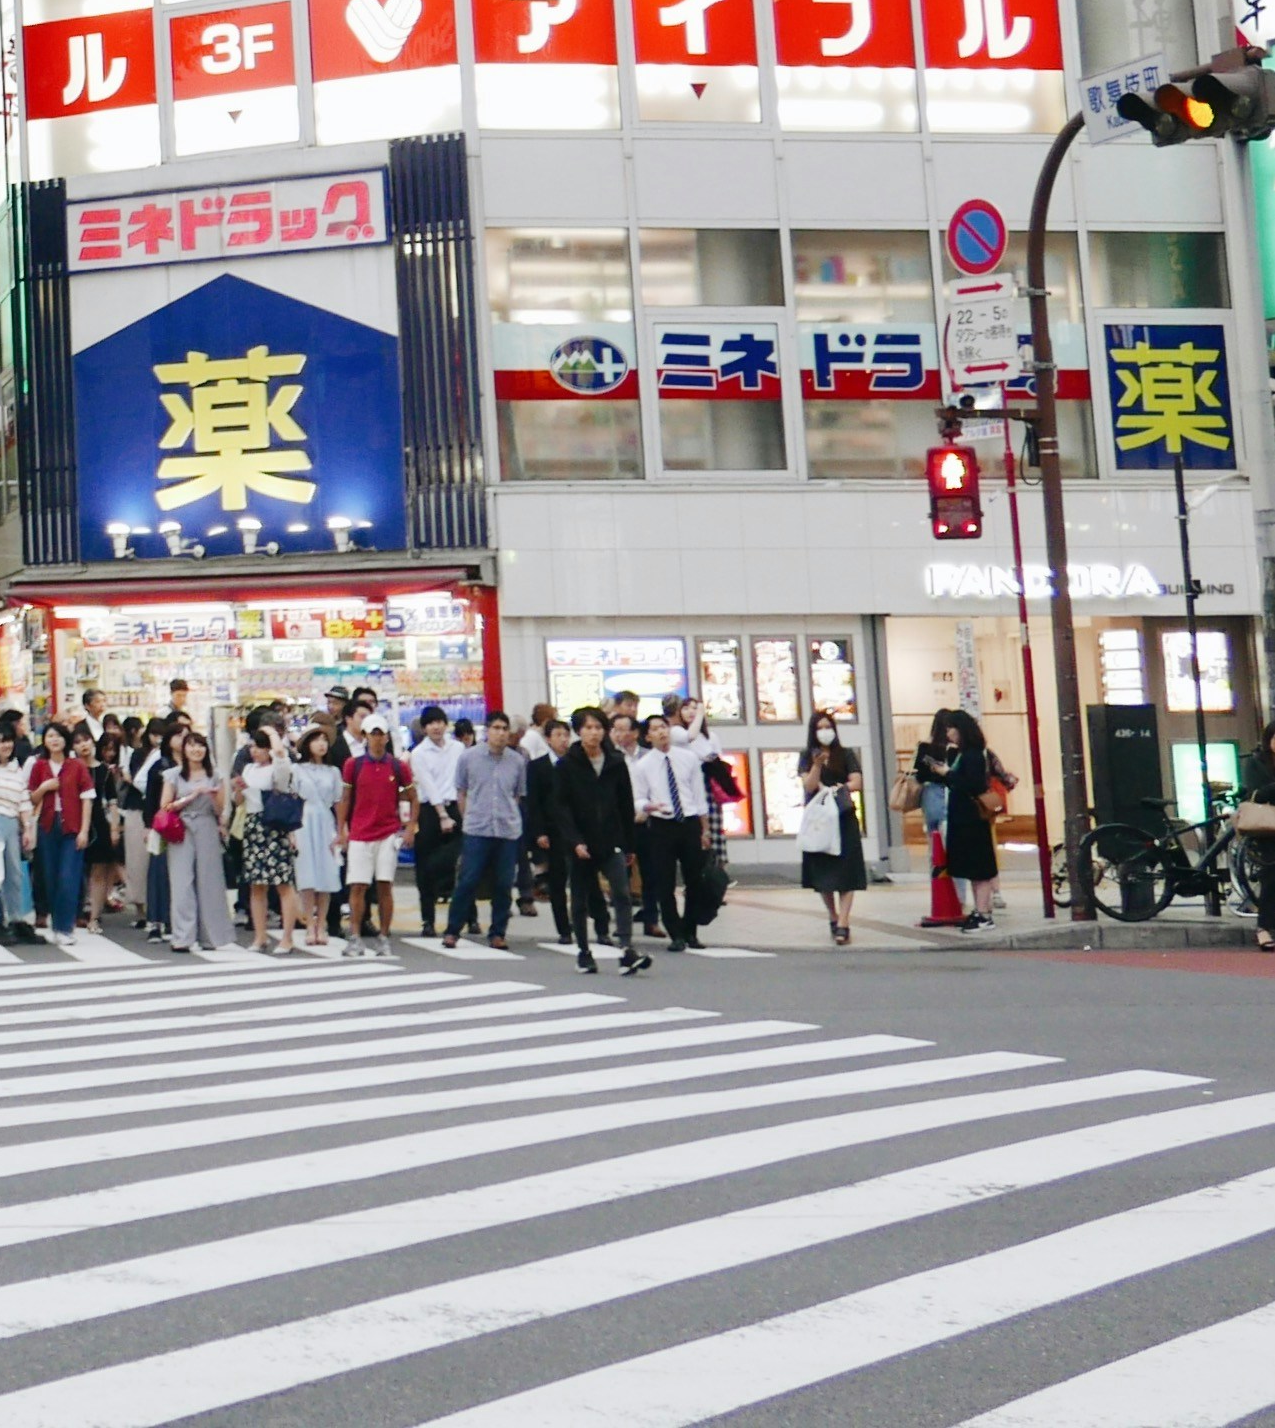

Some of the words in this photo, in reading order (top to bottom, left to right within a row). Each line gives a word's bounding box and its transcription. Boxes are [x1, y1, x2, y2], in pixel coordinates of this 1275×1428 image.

[62, 33, 127, 105] ル
[200, 22, 274, 74] 3F
[957, 310, 973, 324] 22
[153, 345, 316, 511] 薬
[1110, 341, 1228, 454] 薬
[277, 648, 302, 659] VISA
